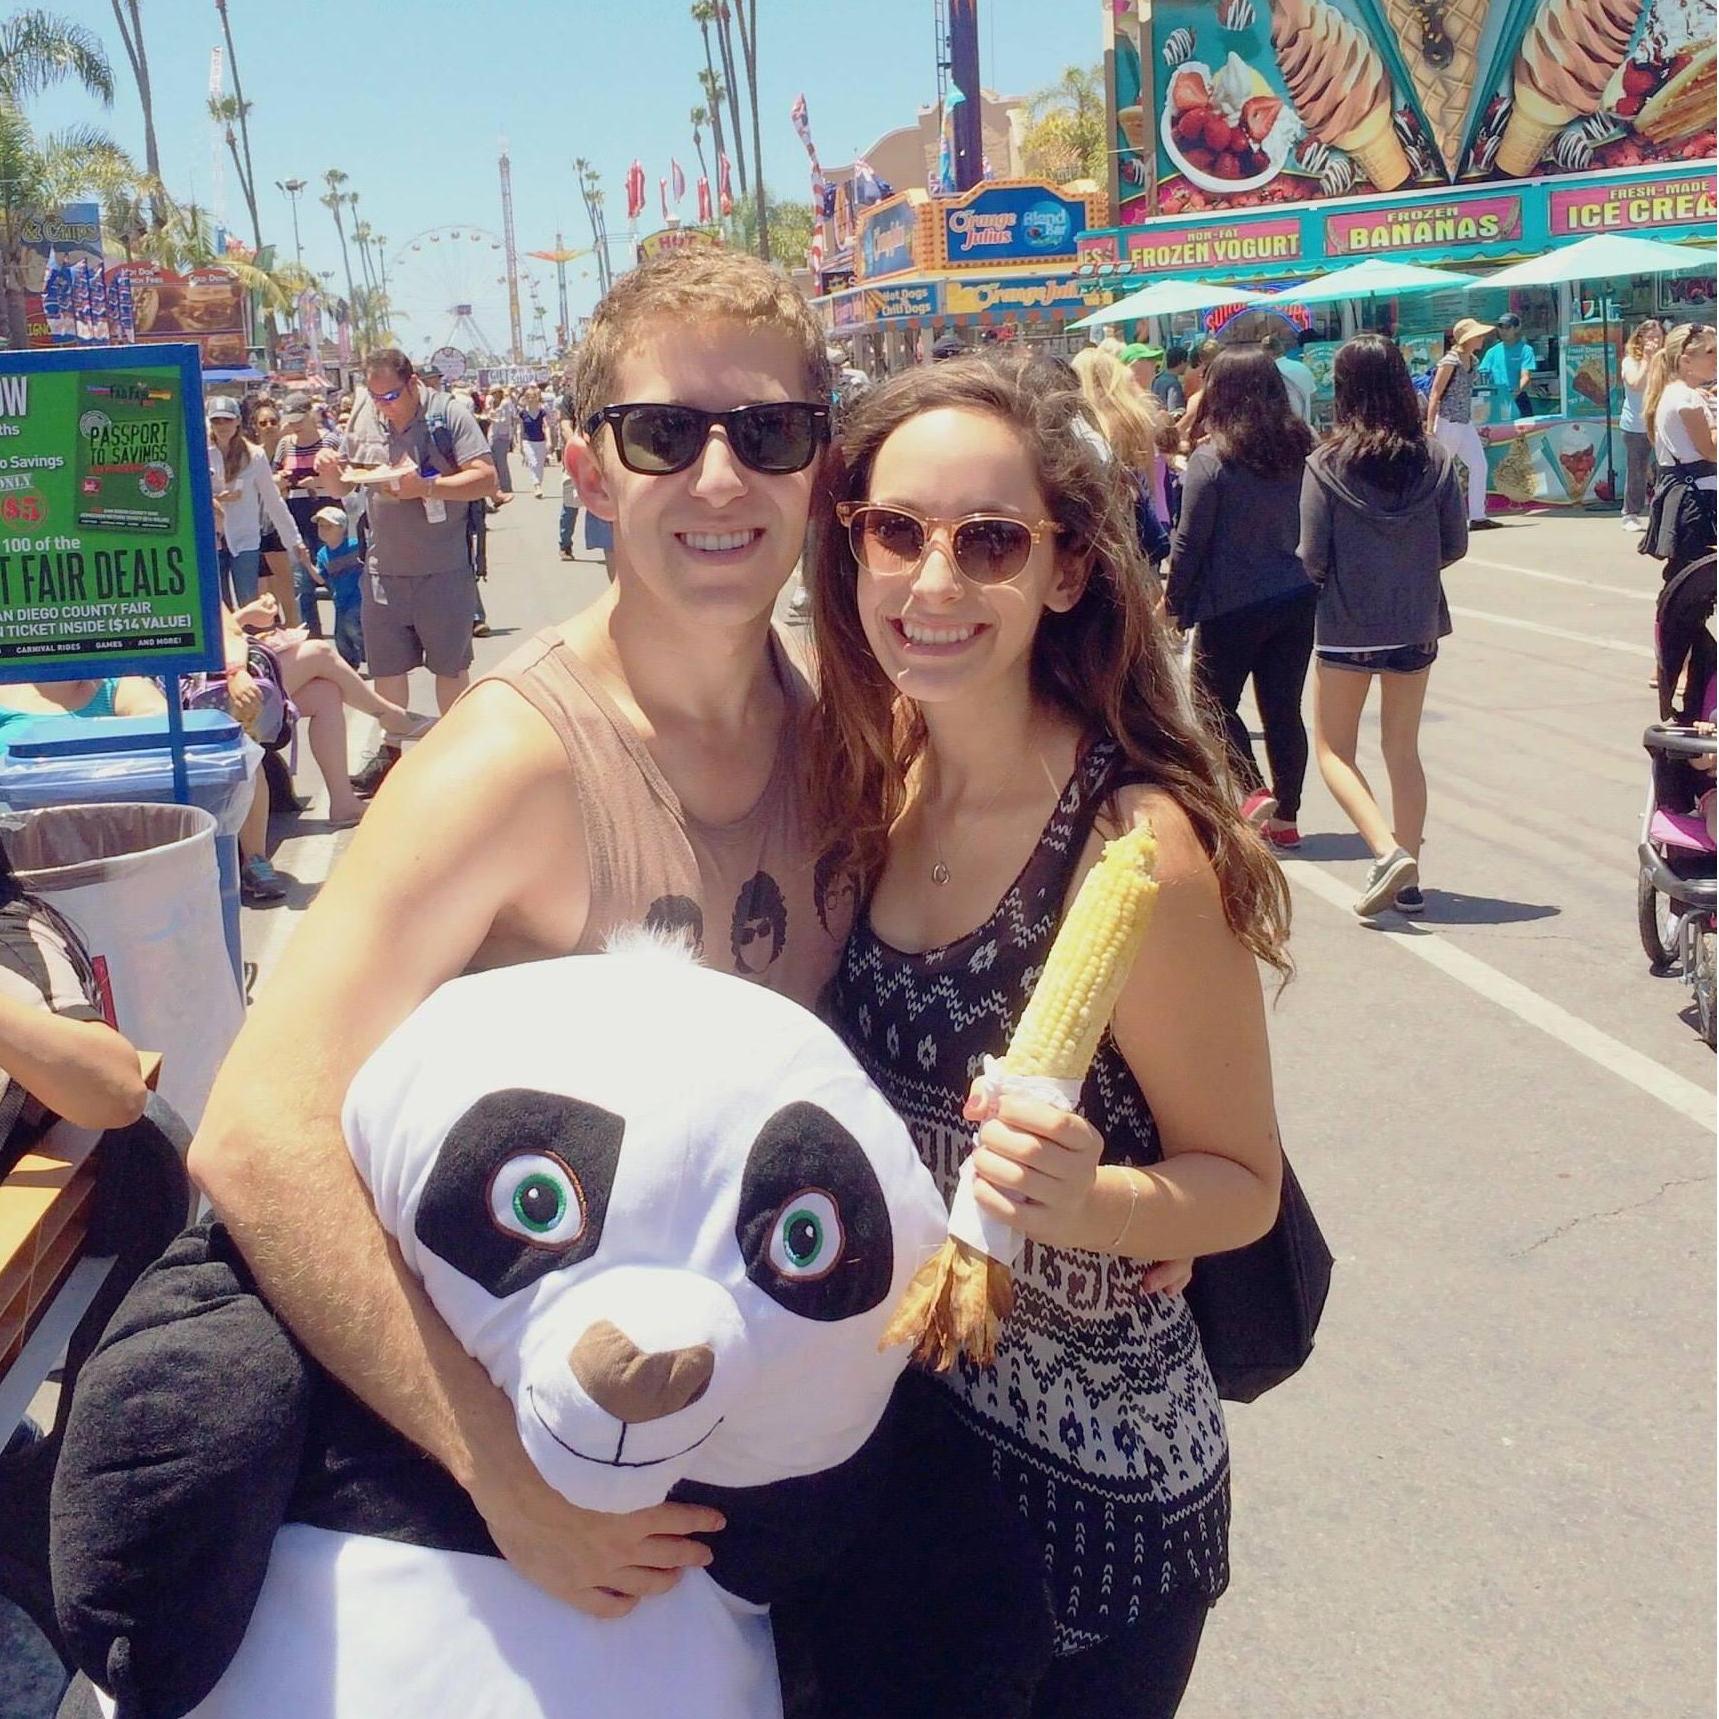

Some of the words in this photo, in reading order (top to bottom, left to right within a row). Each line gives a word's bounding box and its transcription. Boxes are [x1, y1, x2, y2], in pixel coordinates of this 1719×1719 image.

[949, 209, 1017, 233] Orange
[1387, 206, 1459, 222] FROZEN
[1568, 201, 1621, 229] ICE
[1350, 214, 1499, 250] BANANAS
[1131, 242, 1209, 268] FROZEN
[1214, 234, 1300, 262] YOGURT
[901, 288, 928, 300] Dogs
[905, 303, 931, 315] Dogs
[0, 376, 27, 417] W
[90, 421, 169, 448] PASSPORT
[10, 455, 64, 470] Savings
[91, 447, 105, 466] TO
[112, 443, 168, 465] SAVINGS
[2, 537, 31, 553] 100
[35, 536, 51, 551] of
[55, 535, 80, 550] the
[21, 552, 88, 604] FAIR
[94, 546, 186, 599] DEALS
[17, 607, 59, 621] DIEGO
[62, 603, 117, 618] COUNTY
[121, 601, 152, 615] FAIR
[7, 622, 56, 637] TICKET
[60, 620, 106, 634] INSIDE
[141, 614, 192, 629] VALUE)
[16, 645, 57, 653] CARNIVAL
[57, 643, 81, 651] RIDES
[96, 641, 123, 649] GAMES
[138, 638, 155, 646] AND
